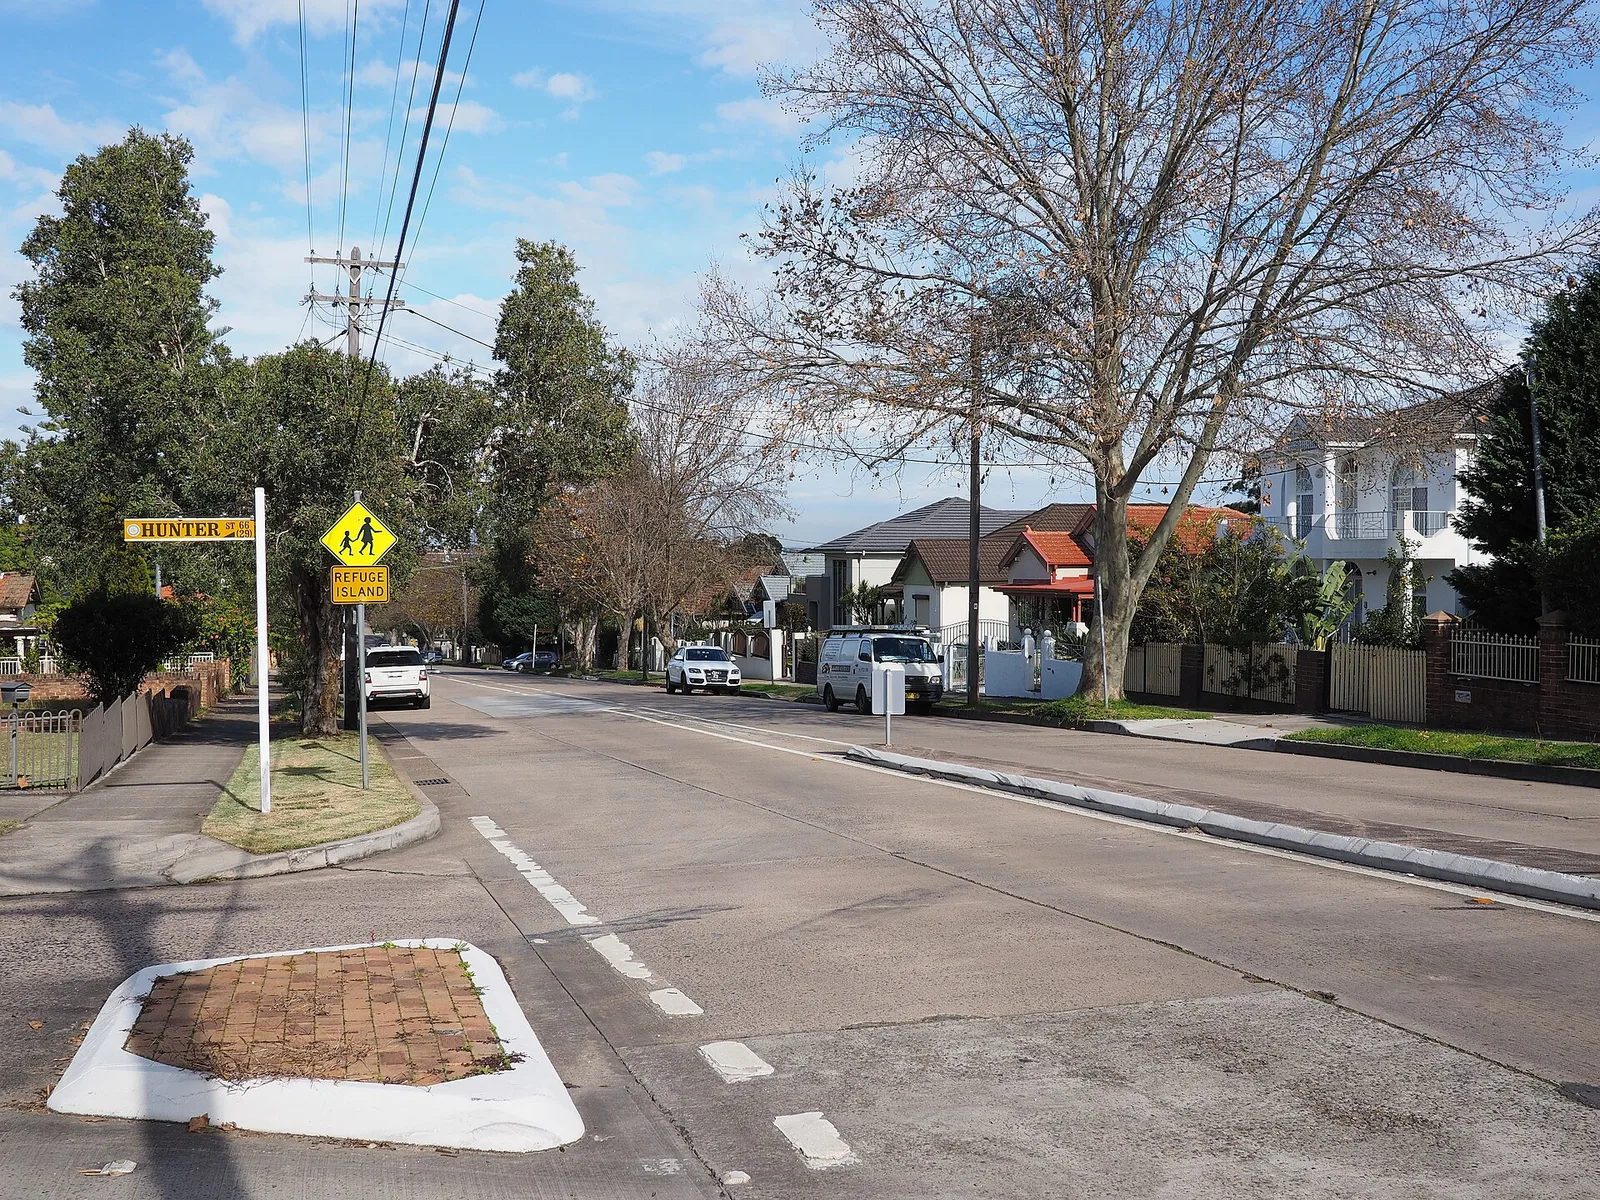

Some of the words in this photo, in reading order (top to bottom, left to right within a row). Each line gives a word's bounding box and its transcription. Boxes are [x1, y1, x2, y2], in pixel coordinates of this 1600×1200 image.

[141, 522, 221, 537] HUNTER
[225, 522, 236, 530] ST
[239, 521, 250, 529] 66
[236, 529, 253, 538] (29)
[334, 572, 384, 583] REFUGE
[336, 586, 384, 597] ISLAND
